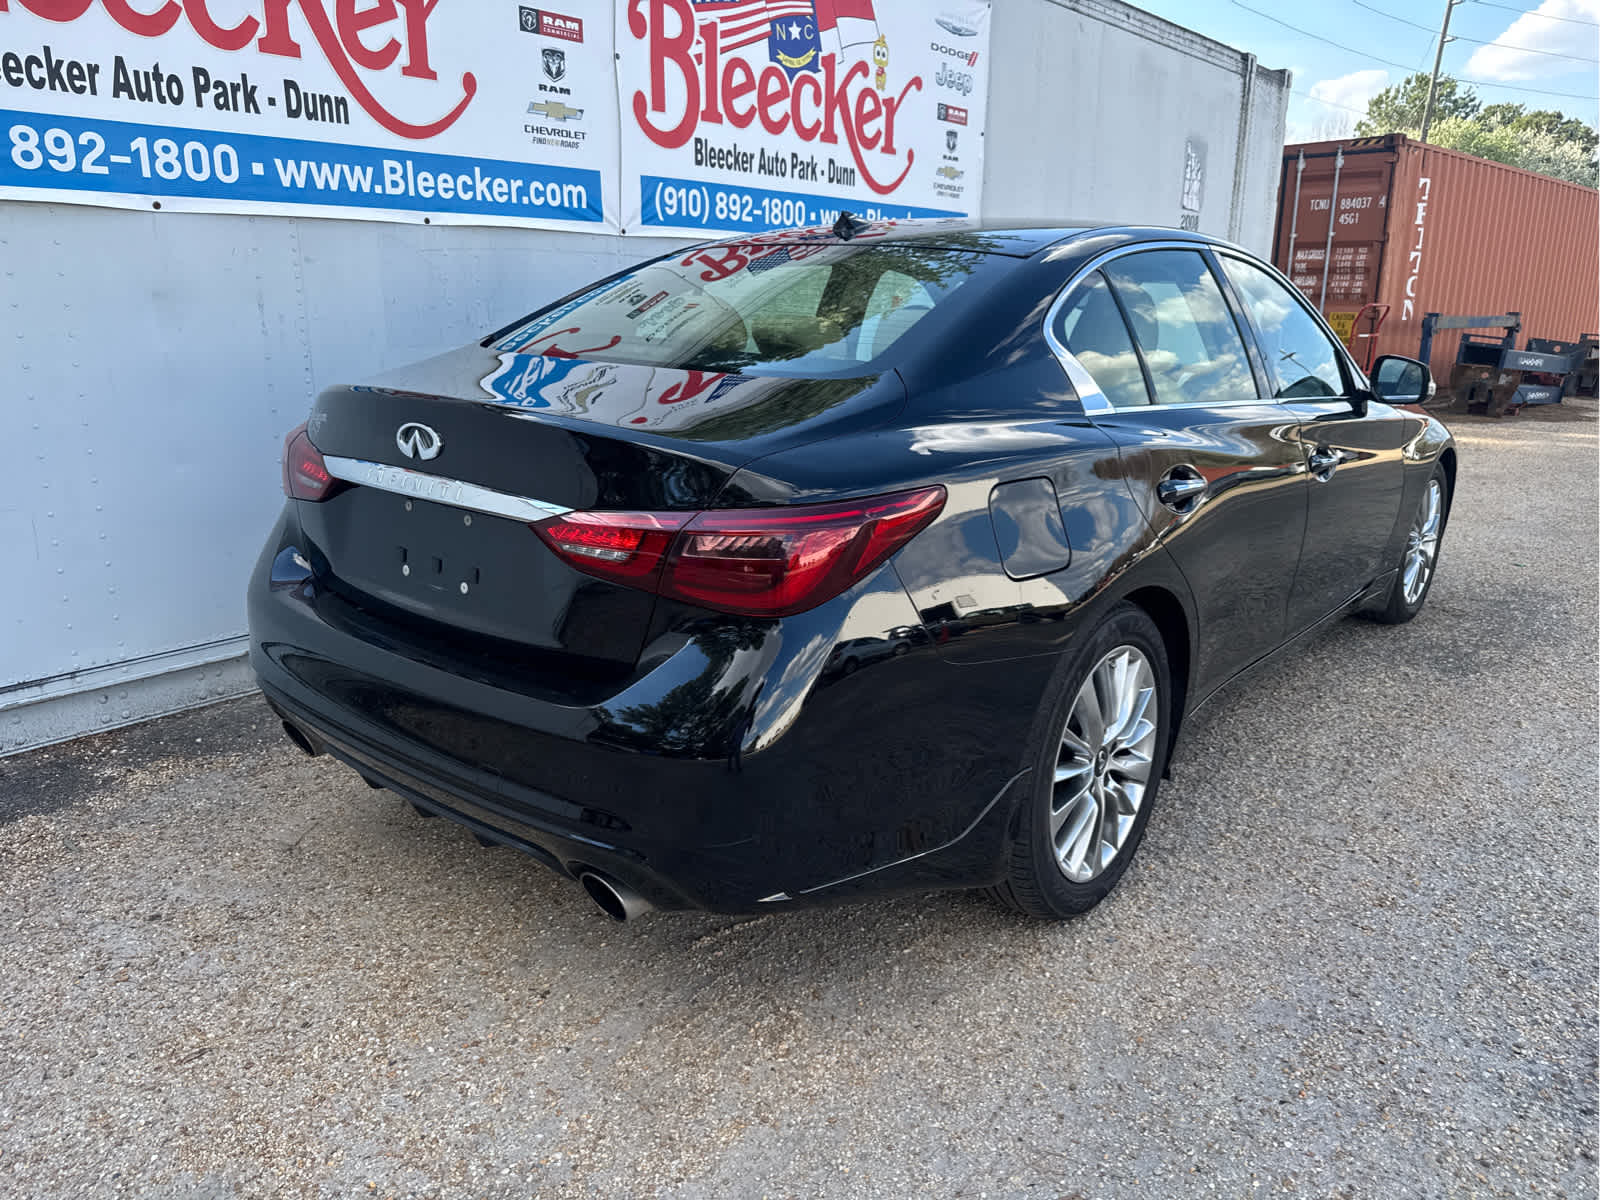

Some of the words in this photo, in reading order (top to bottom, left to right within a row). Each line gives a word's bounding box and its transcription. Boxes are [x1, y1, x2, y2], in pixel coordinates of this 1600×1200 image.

[542, 15, 579, 31] RAM
[930, 42, 972, 61] DODGE
[0, 46, 100, 96] ecker
[112, 55, 184, 106] Auto
[192, 66, 261, 115] Park
[283, 79, 349, 125] Dunn
[538, 84, 571, 96] RAM
[935, 62, 973, 96] Jeep
[628, 0, 922, 195] Bleecker
[524, 124, 585, 140] CHEVROLET
[8, 124, 240, 184] 892-1800
[274, 158, 587, 209] www.Bleecker.com
[694, 137, 755, 174] Bleecker
[758, 148, 787, 179] Auto
[791, 156, 818, 182] Park
[828, 162, 856, 187] Dunn
[655, 181, 710, 225] (910)
[715, 193, 805, 227] 892-1800
[1310, 199, 1330, 211] TCNU
[1340, 197, 1372, 210] 884037
[1338, 212, 1360, 225] 45G1
[364, 466, 465, 504] INFINITI
